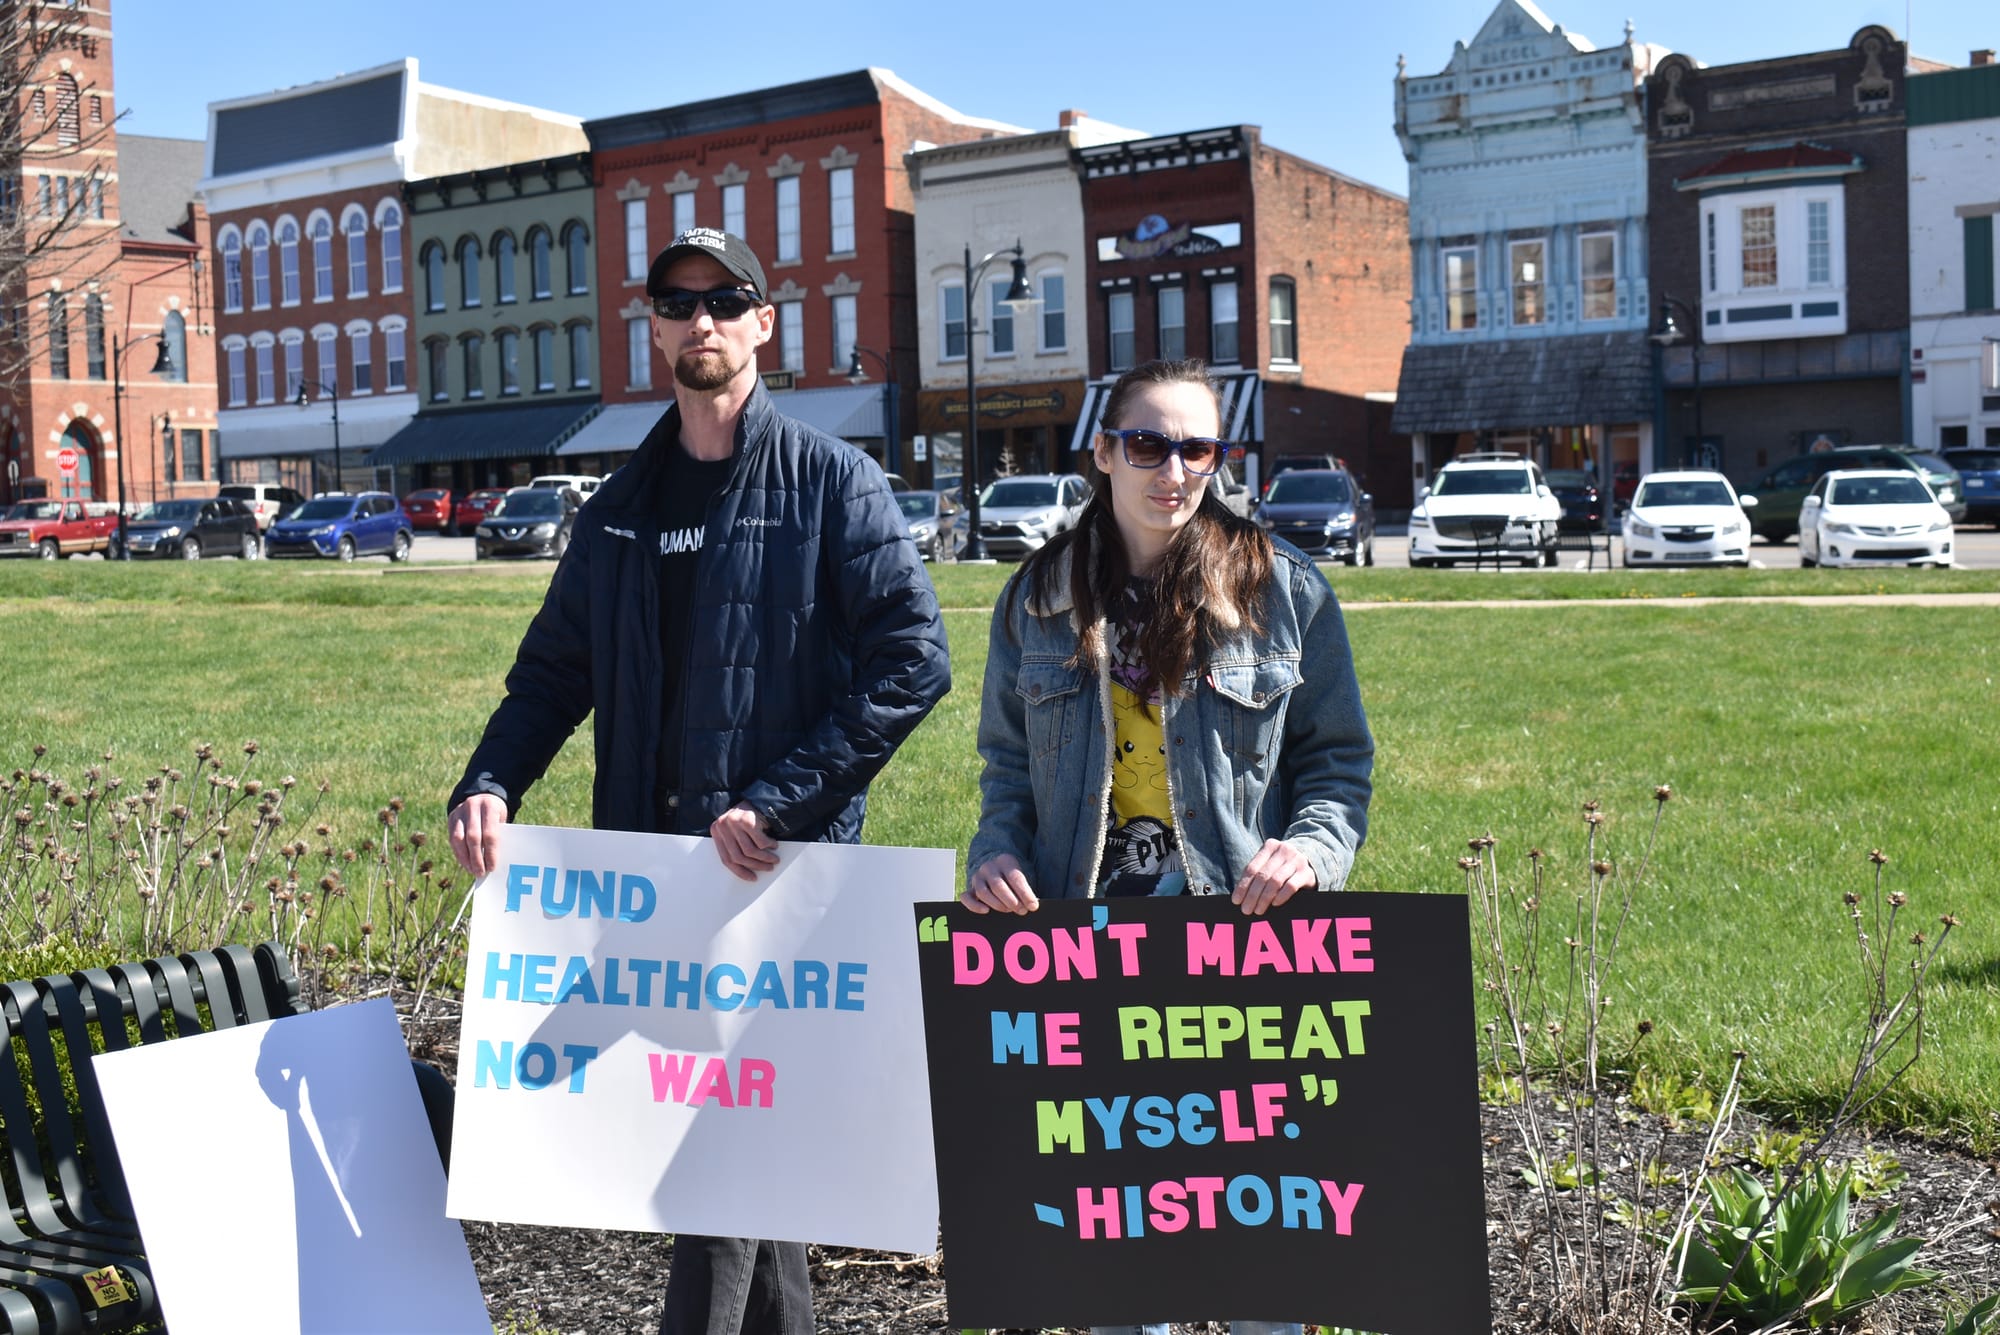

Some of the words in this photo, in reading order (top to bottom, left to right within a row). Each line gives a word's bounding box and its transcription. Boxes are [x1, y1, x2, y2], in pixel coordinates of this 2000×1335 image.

[58, 454, 77, 465] STOP
[743, 516, 782, 527] Columbia
[505, 864, 657, 923] FUND
[1186, 917, 1375, 977] MAKE
[484, 952, 868, 1013] HEALTHCARE
[990, 1010, 1083, 1066] ME
[1117, 1000, 1372, 1061] REPEAT
[474, 1038, 598, 1094] NOT
[648, 1053, 776, 1108] WAR
